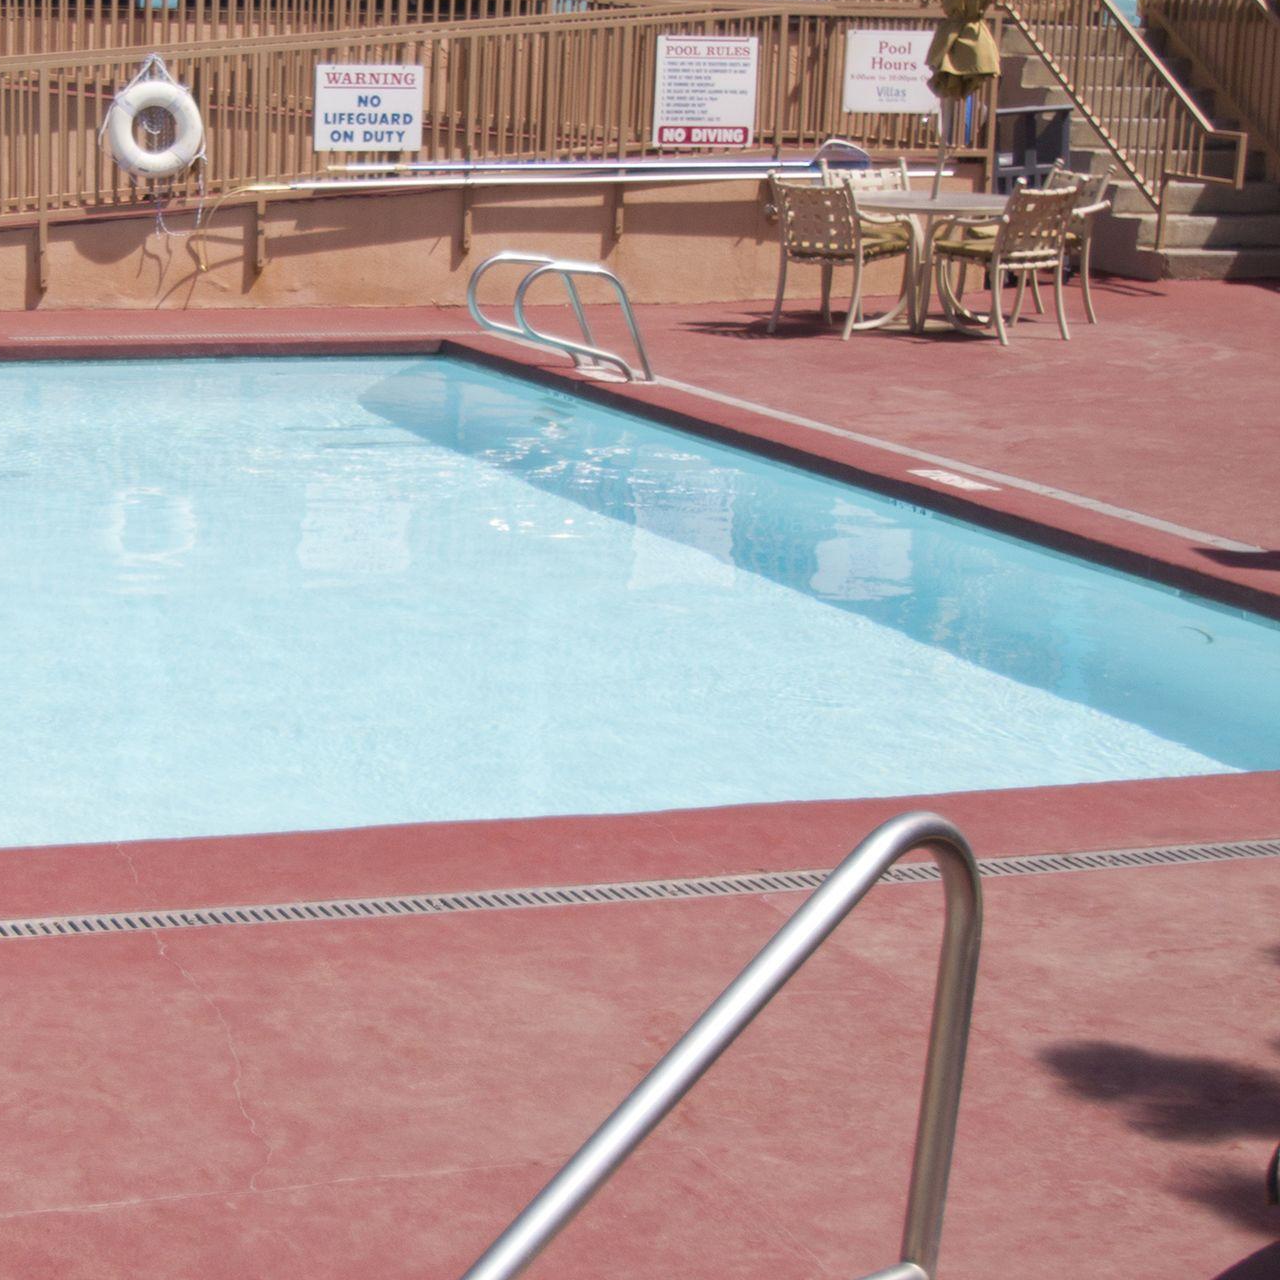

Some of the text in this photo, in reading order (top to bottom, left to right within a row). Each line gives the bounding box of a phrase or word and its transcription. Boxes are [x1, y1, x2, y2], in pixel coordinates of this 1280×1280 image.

[665, 45, 751, 56] POOL RULES
[879, 41, 912, 55] Pool
[871, 57, 917, 71] Hours
[325, 72, 416, 86] WARNING
[876, 86, 907, 97] Villas
[357, 95, 381, 107] NO
[324, 112, 413, 125] LIFEGUARD
[330, 130, 406, 142] ON DUTY
[662, 128, 744, 143] NO DIVING
